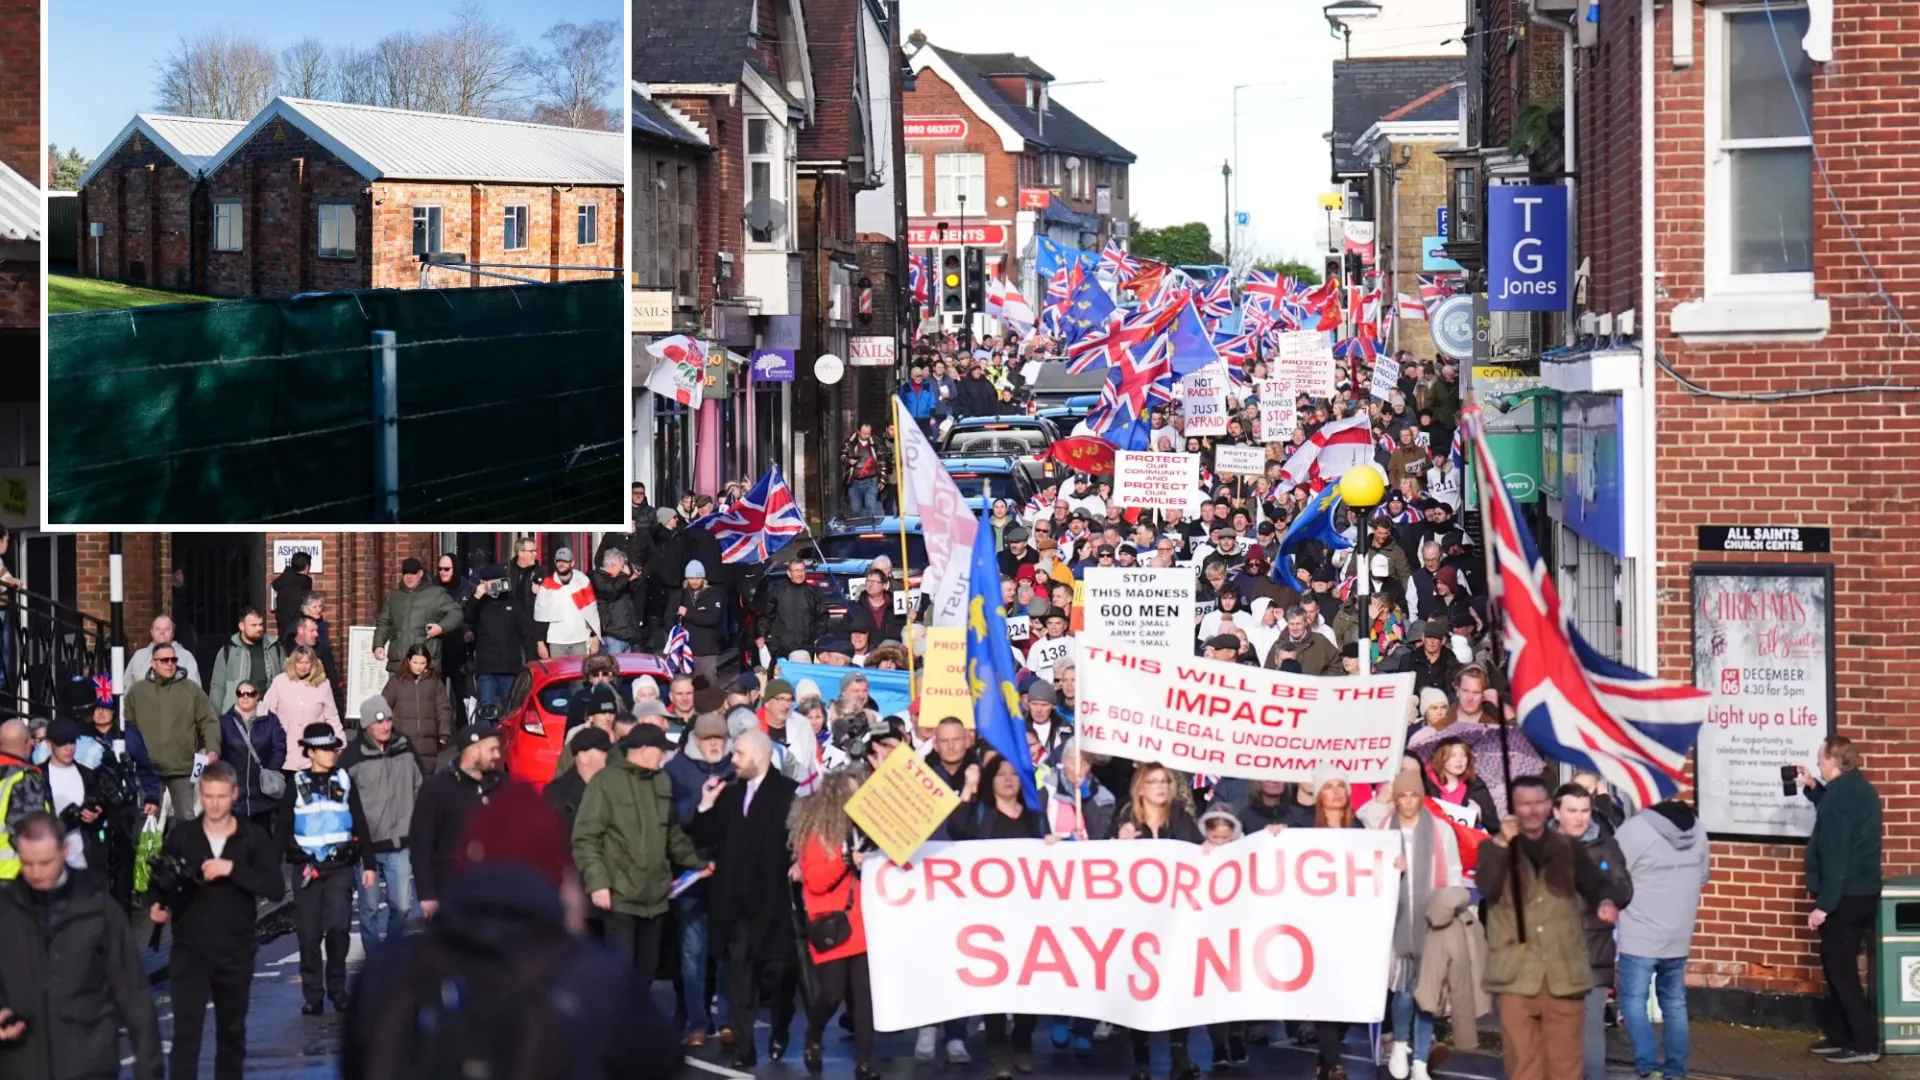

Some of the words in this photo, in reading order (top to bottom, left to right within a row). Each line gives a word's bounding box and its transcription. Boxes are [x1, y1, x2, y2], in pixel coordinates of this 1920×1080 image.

[1513, 198, 1543, 232] T
[908, 229, 926, 240] TE
[929, 229, 985, 241] AGENTS
[1512, 238, 1543, 274] G
[1498, 277, 1557, 299] Jones
[633, 307, 669, 317] NAILS
[850, 345, 894, 358] NAILS
[1194, 379, 1213, 388] NOT
[1265, 382, 1291, 393] STOP
[1187, 387, 1221, 397] RACIST
[1192, 404, 1219, 415] JUST
[1186, 416, 1225, 428] AFRAID
[1267, 410, 1293, 422] STOP
[1267, 427, 1294, 437] BOATS
[1125, 454, 1190, 463] PROTECT
[1124, 468, 1188, 476] COMMUNITY
[1123, 482, 1188, 490] PROTECT
[1434, 480, 1454, 492] 211
[1123, 496, 1187, 505] FAMILIES
[1727, 528, 1751, 540] ALL
[1754, 528, 1799, 540] SAINTS
[1724, 540, 1763, 550] CHURCH
[1765, 541, 1803, 551] CENTRE
[1123, 574, 1157, 583] STOP
[1091, 588, 1122, 598] THIS
[1125, 589, 1189, 598] MADNESS
[1100, 604, 1132, 617] 600
[1139, 605, 1179, 617] MEN
[933, 641, 967, 651] PROT
[1040, 644, 1067, 662] 138
[945, 665, 967, 674] OU
[1084, 646, 1162, 675] THIS
[1176, 666, 1256, 693] WILL
[1271, 684, 1319, 700] BE
[1333, 686, 1396, 701] THE
[1743, 668, 1804, 680] DECEMBER
[1722, 681, 1738, 694] 06
[1743, 684, 1765, 695] 4.30
[1766, 683, 1781, 695] for
[1783, 684, 1805, 698] 5pm
[1165, 686, 1308, 729] IMPACT
[1707, 704, 1744, 729] Light
[1748, 713, 1769, 730] up
[1774, 713, 1785, 725] a
[1790, 706, 1818, 727] Life
[1081, 700, 1099, 715] OF
[1108, 705, 1144, 725] 600
[1150, 714, 1225, 742] ILLEGAL
[1231, 731, 1391, 750] UNDOCUMENTED
[1080, 723, 1129, 744] MEN
[1138, 734, 1163, 751] IN
[1172, 743, 1225, 764] OUR
[1235, 752, 1390, 771] COMMNITY
[193, 762, 203, 777] 3
[903, 759, 944, 798] STOP
[874, 848, 1385, 912] CROWBOROUGH
[955, 923, 1161, 1002] SAYS
[1193, 923, 1315, 998] NO
